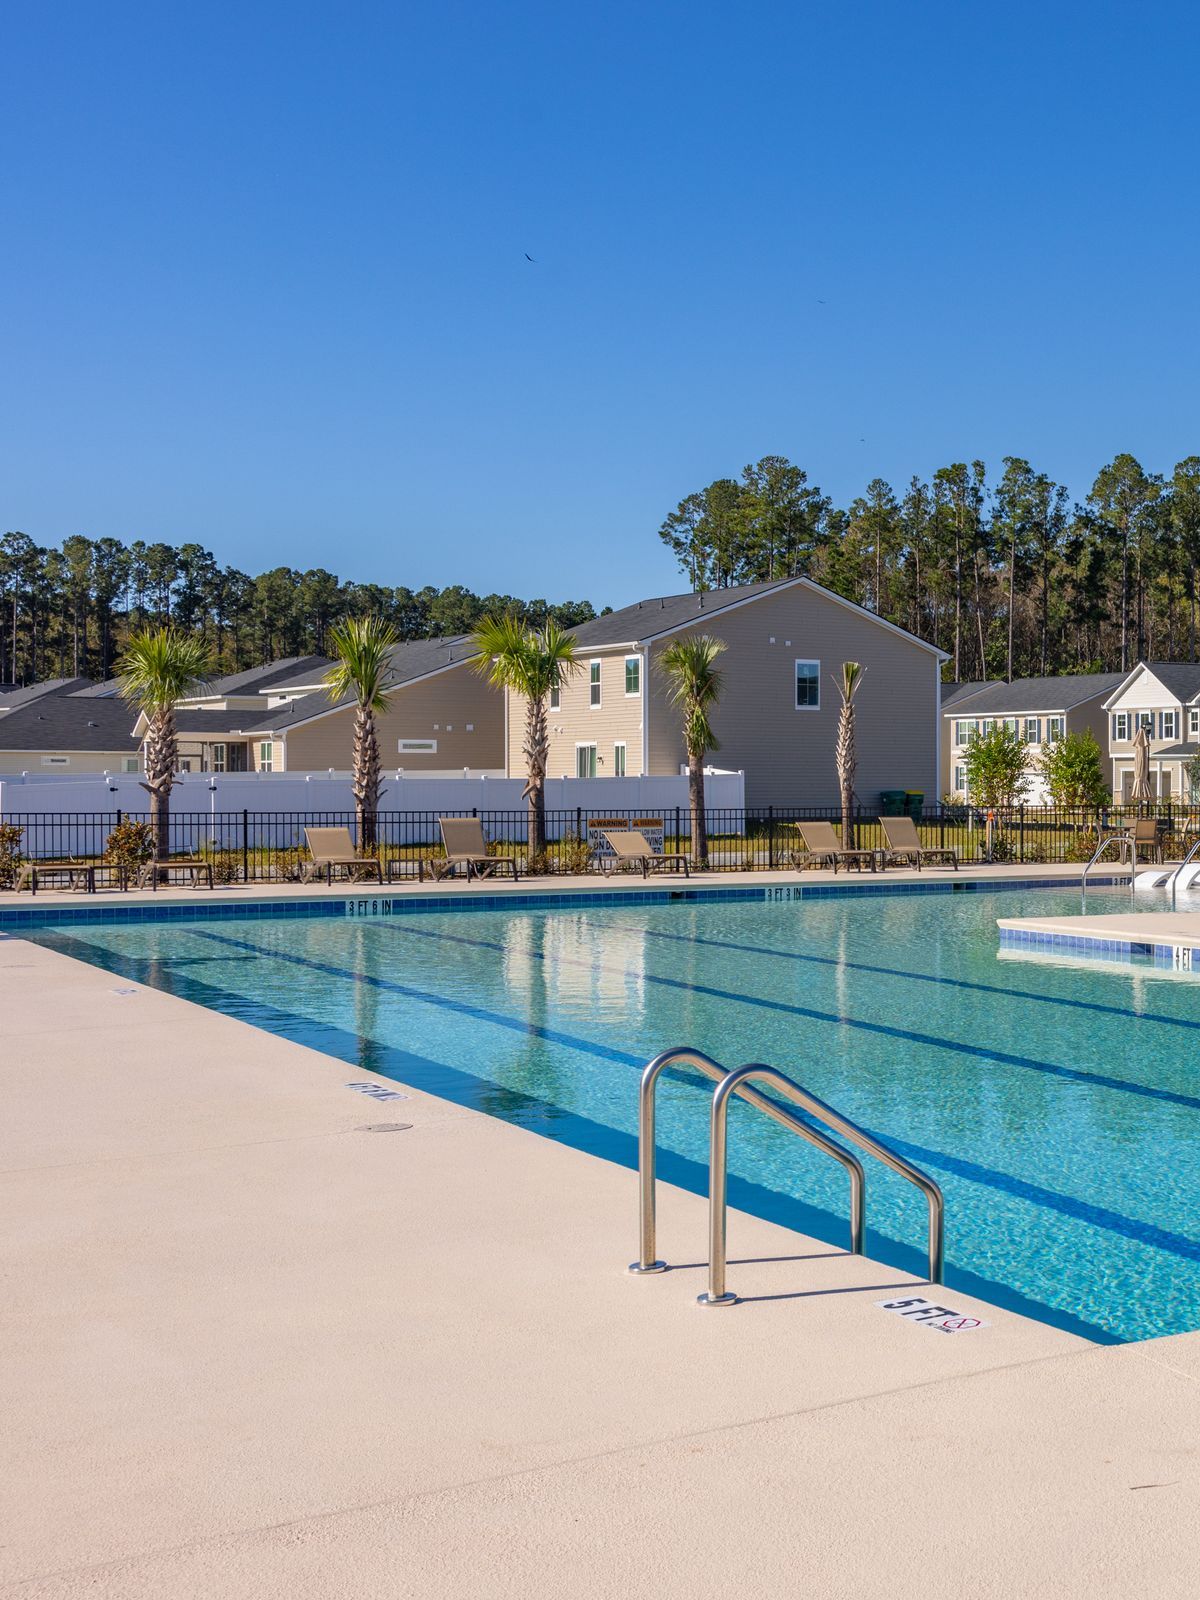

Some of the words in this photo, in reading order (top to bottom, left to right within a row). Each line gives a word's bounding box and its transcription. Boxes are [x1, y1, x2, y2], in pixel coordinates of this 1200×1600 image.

[589, 830, 598, 839] NO
[1120, 877, 1127, 885] FT
[768, 888, 773, 897] 3
[774, 888, 783, 898] FT
[786, 888, 791, 897] 3
[794, 887, 801, 897] IN
[349, 900, 355, 911] 3
[358, 900, 369, 912] FT
[372, 900, 378, 911] 6
[382, 899, 391, 912] IN
[1175, 946, 1180, 959] 4
[1182, 947, 1191, 960] FT
[883, 1297, 928, 1309] 5
[901, 1306, 961, 1322] FT
